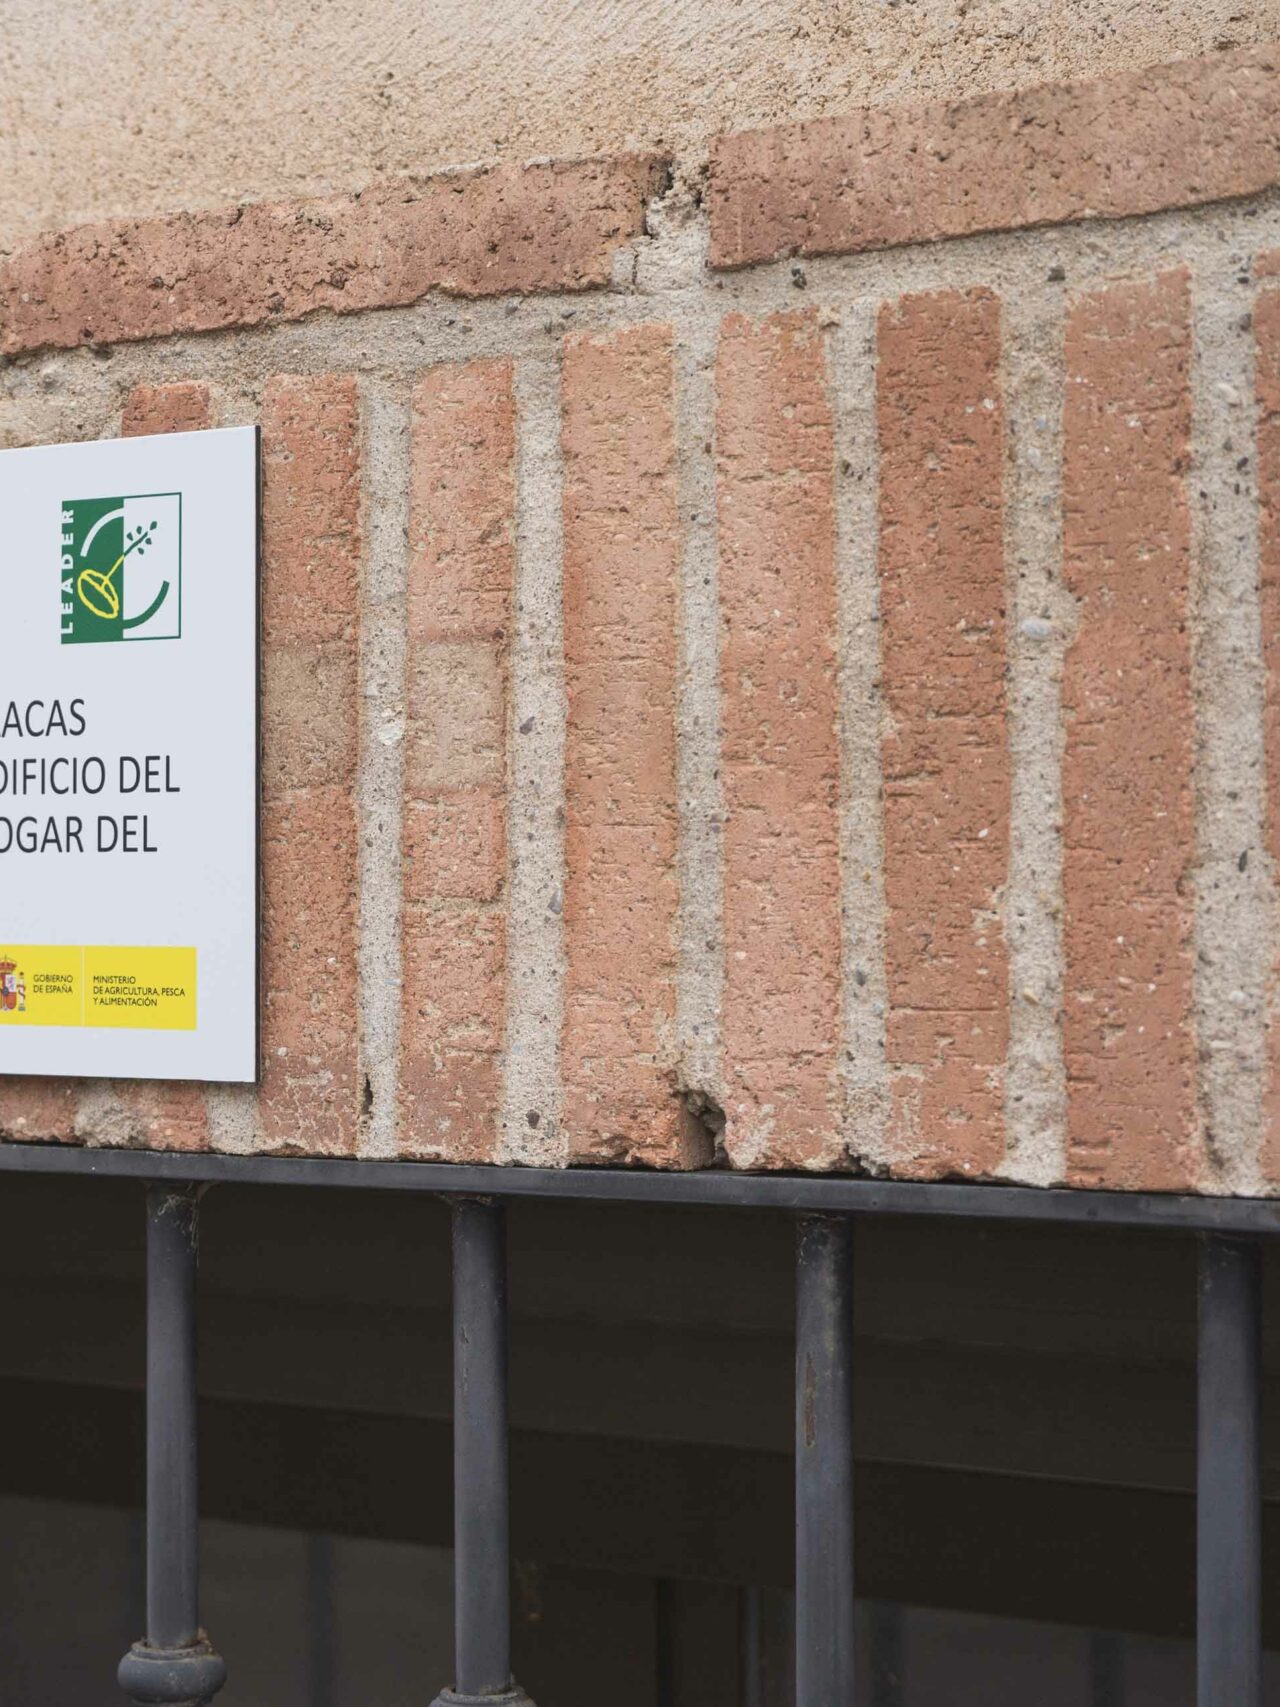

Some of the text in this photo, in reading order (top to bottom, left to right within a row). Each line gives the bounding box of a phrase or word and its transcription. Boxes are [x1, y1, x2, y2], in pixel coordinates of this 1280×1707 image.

[61, 509, 74, 635] LEADER
[119, 755, 181, 794] DEL
[96, 814, 158, 853] DEL
[33, 974, 73, 984] GOBIERNO
[93, 975, 136, 984] MINISTERIO
[33, 984, 73, 994] DE ESPAÑA
[93, 986, 104, 995] DE
[161, 988, 186, 997] PESCA
[93, 996, 158, 1007] Y ALIMENTACIÓN
